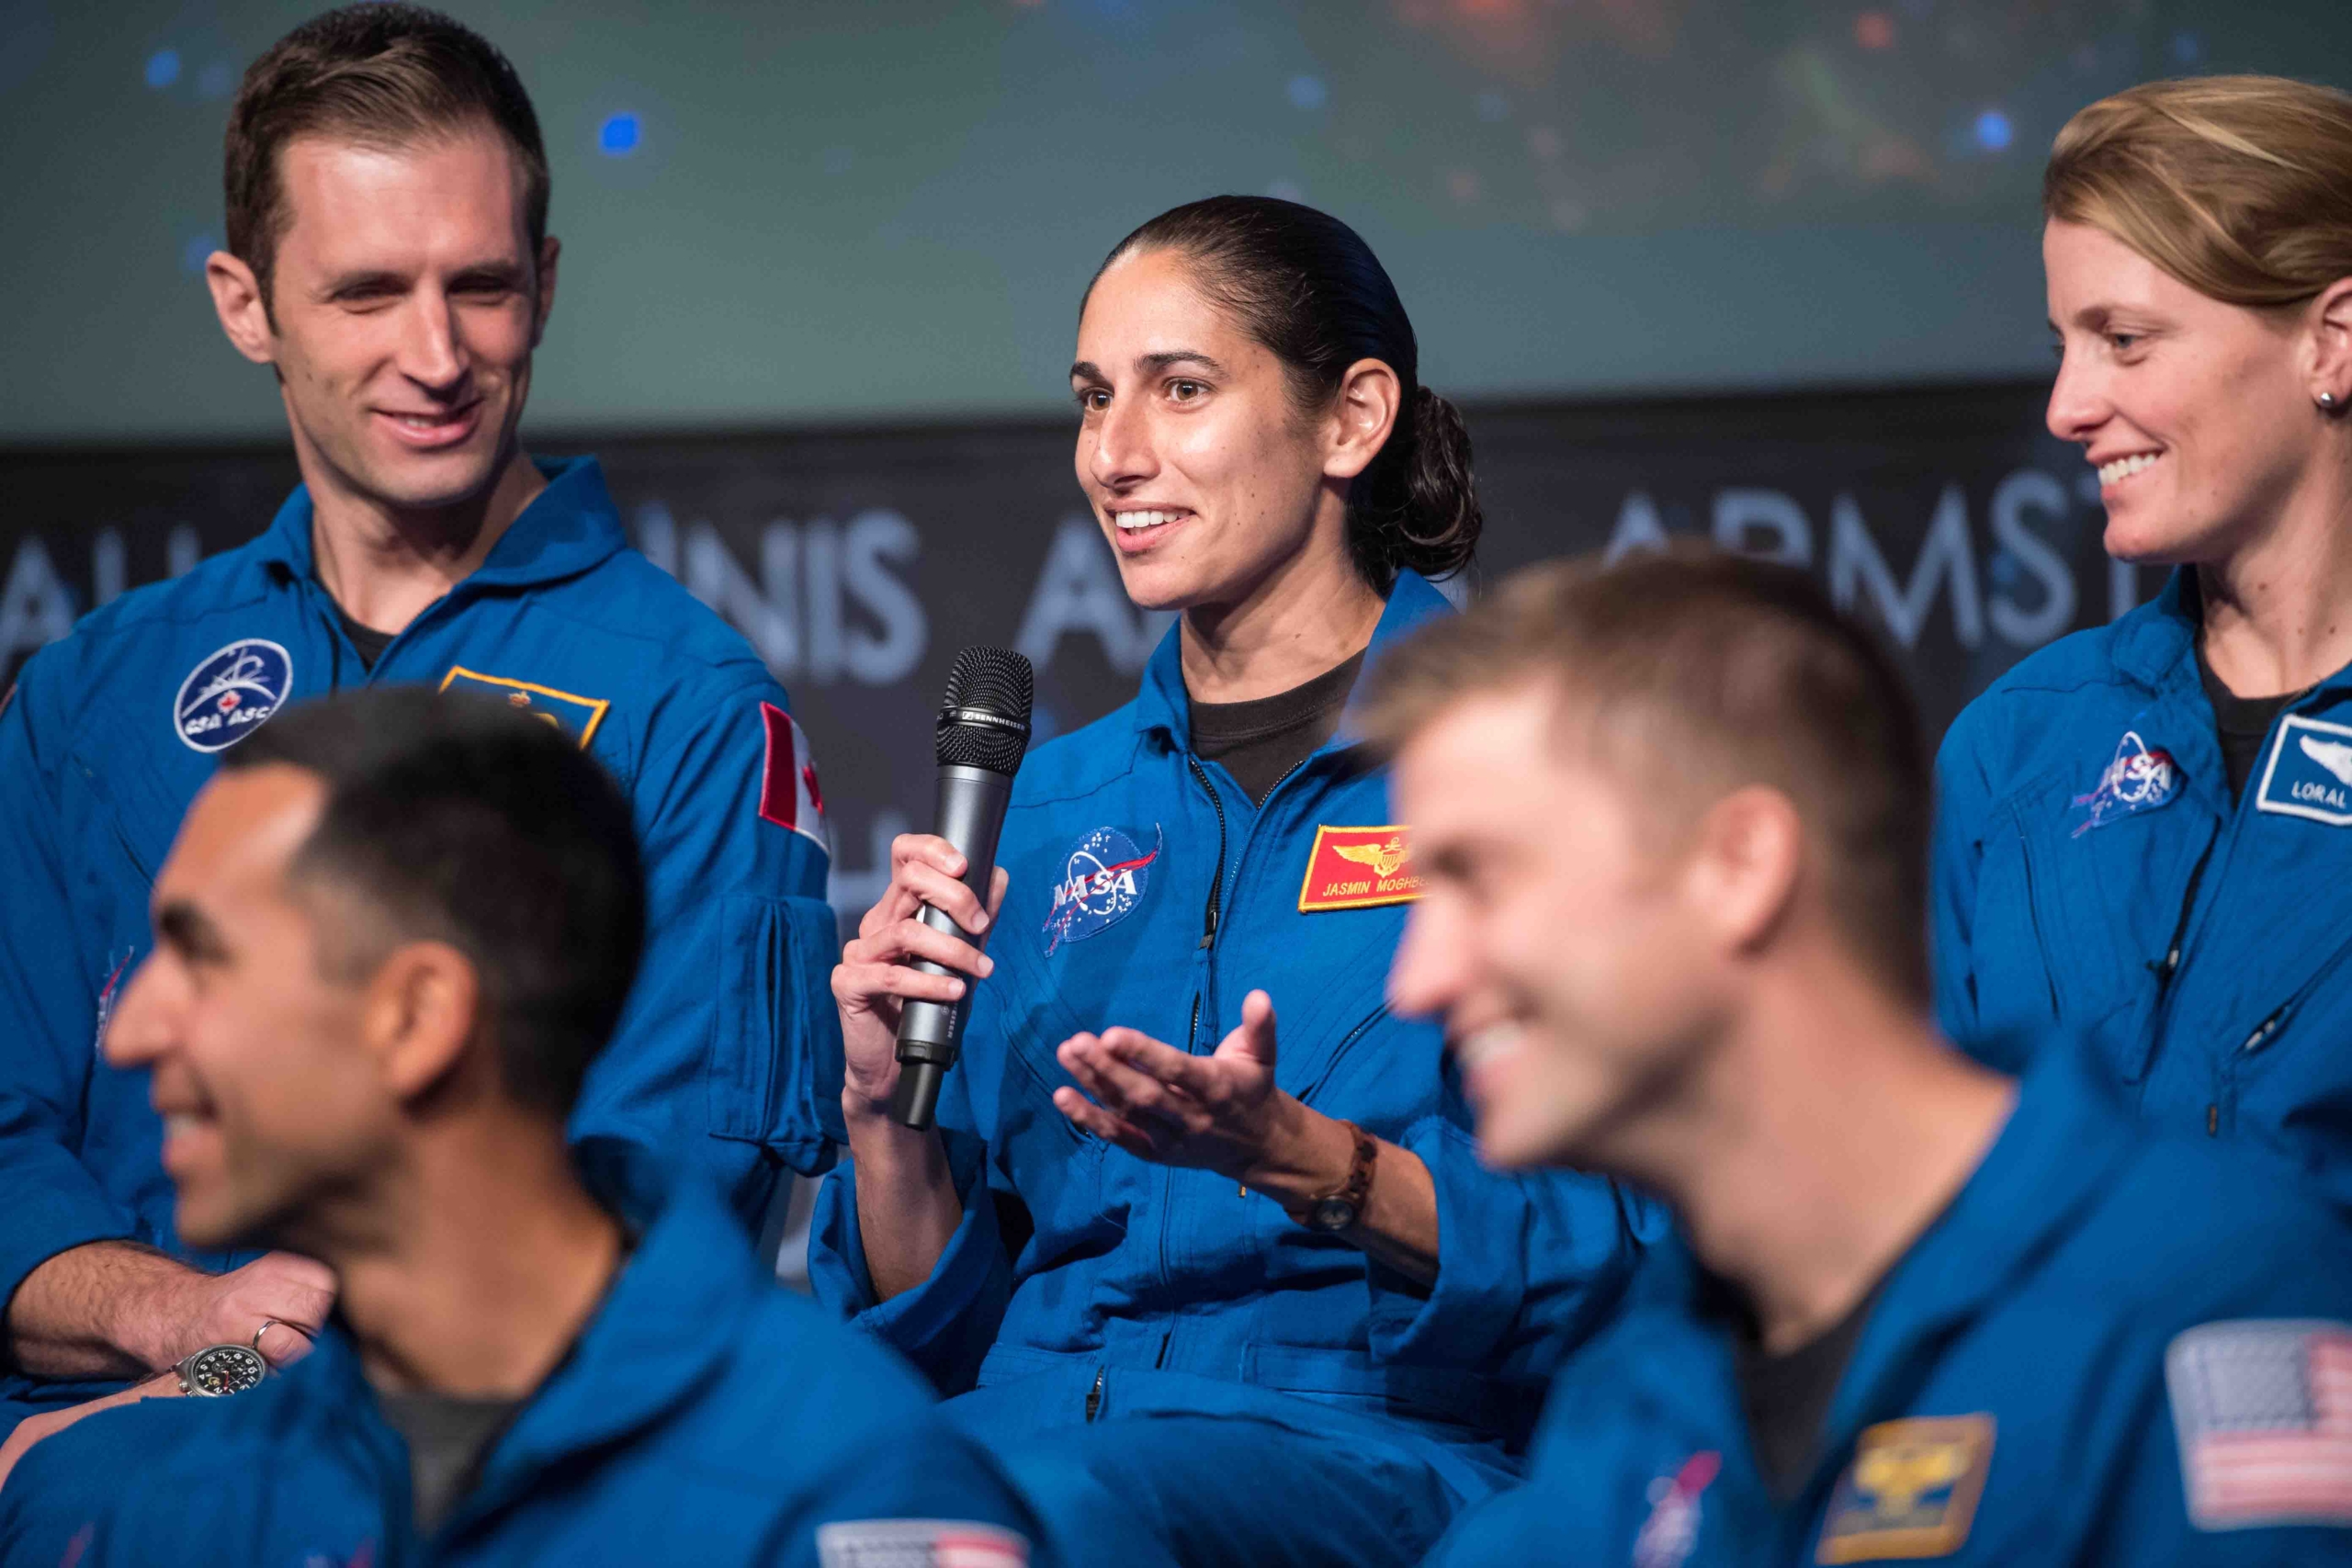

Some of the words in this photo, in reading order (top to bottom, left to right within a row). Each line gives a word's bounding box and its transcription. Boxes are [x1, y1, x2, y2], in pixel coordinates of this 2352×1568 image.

[975, 713, 1025, 731] SENNHEISER
[1054, 868, 1137, 910] NASA
[1322, 880, 1372, 897] JASMIN
